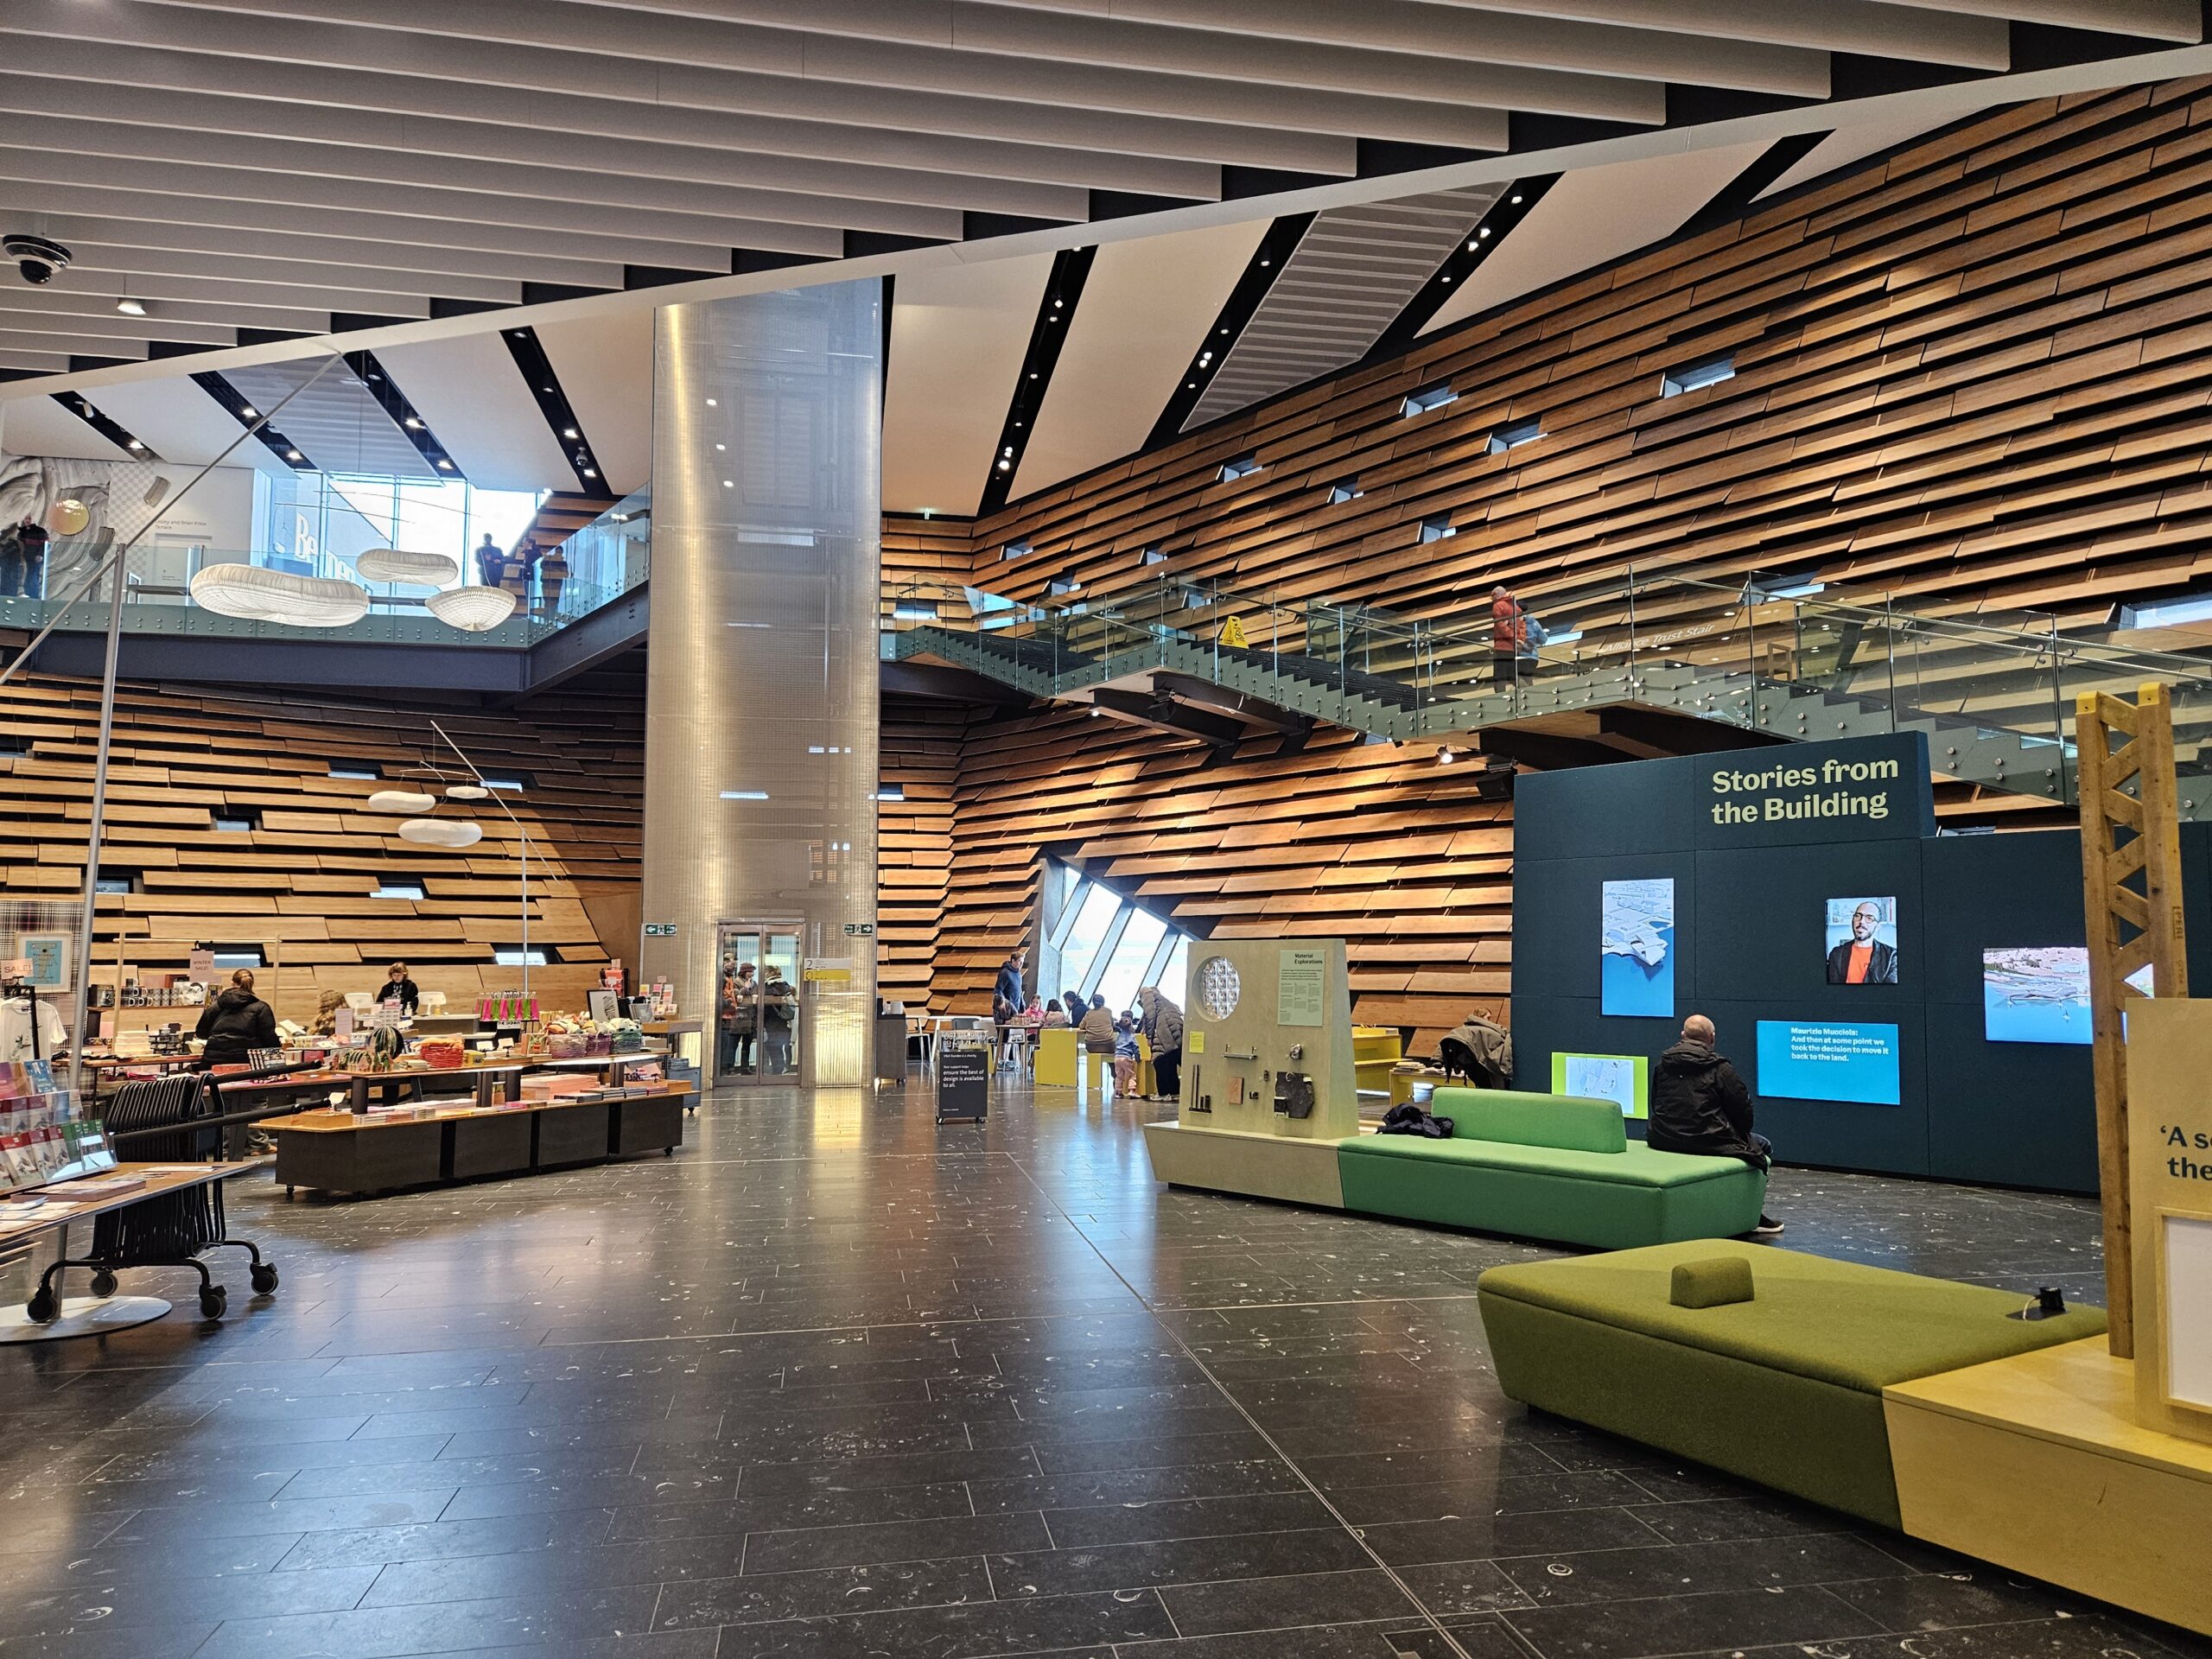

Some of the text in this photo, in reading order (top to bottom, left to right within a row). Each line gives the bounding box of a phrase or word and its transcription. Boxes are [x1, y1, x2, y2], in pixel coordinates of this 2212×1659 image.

[1653, 630, 1683, 644] Trust
[1685, 624, 1715, 637] Stair
[1713, 759, 1898, 793] Stories from
[1711, 791, 1889, 824] the Building
[4, 964, 31, 973] SALE!
[1821, 1045, 1853, 1053] decision
[1853, 1038, 1873, 1046] point
